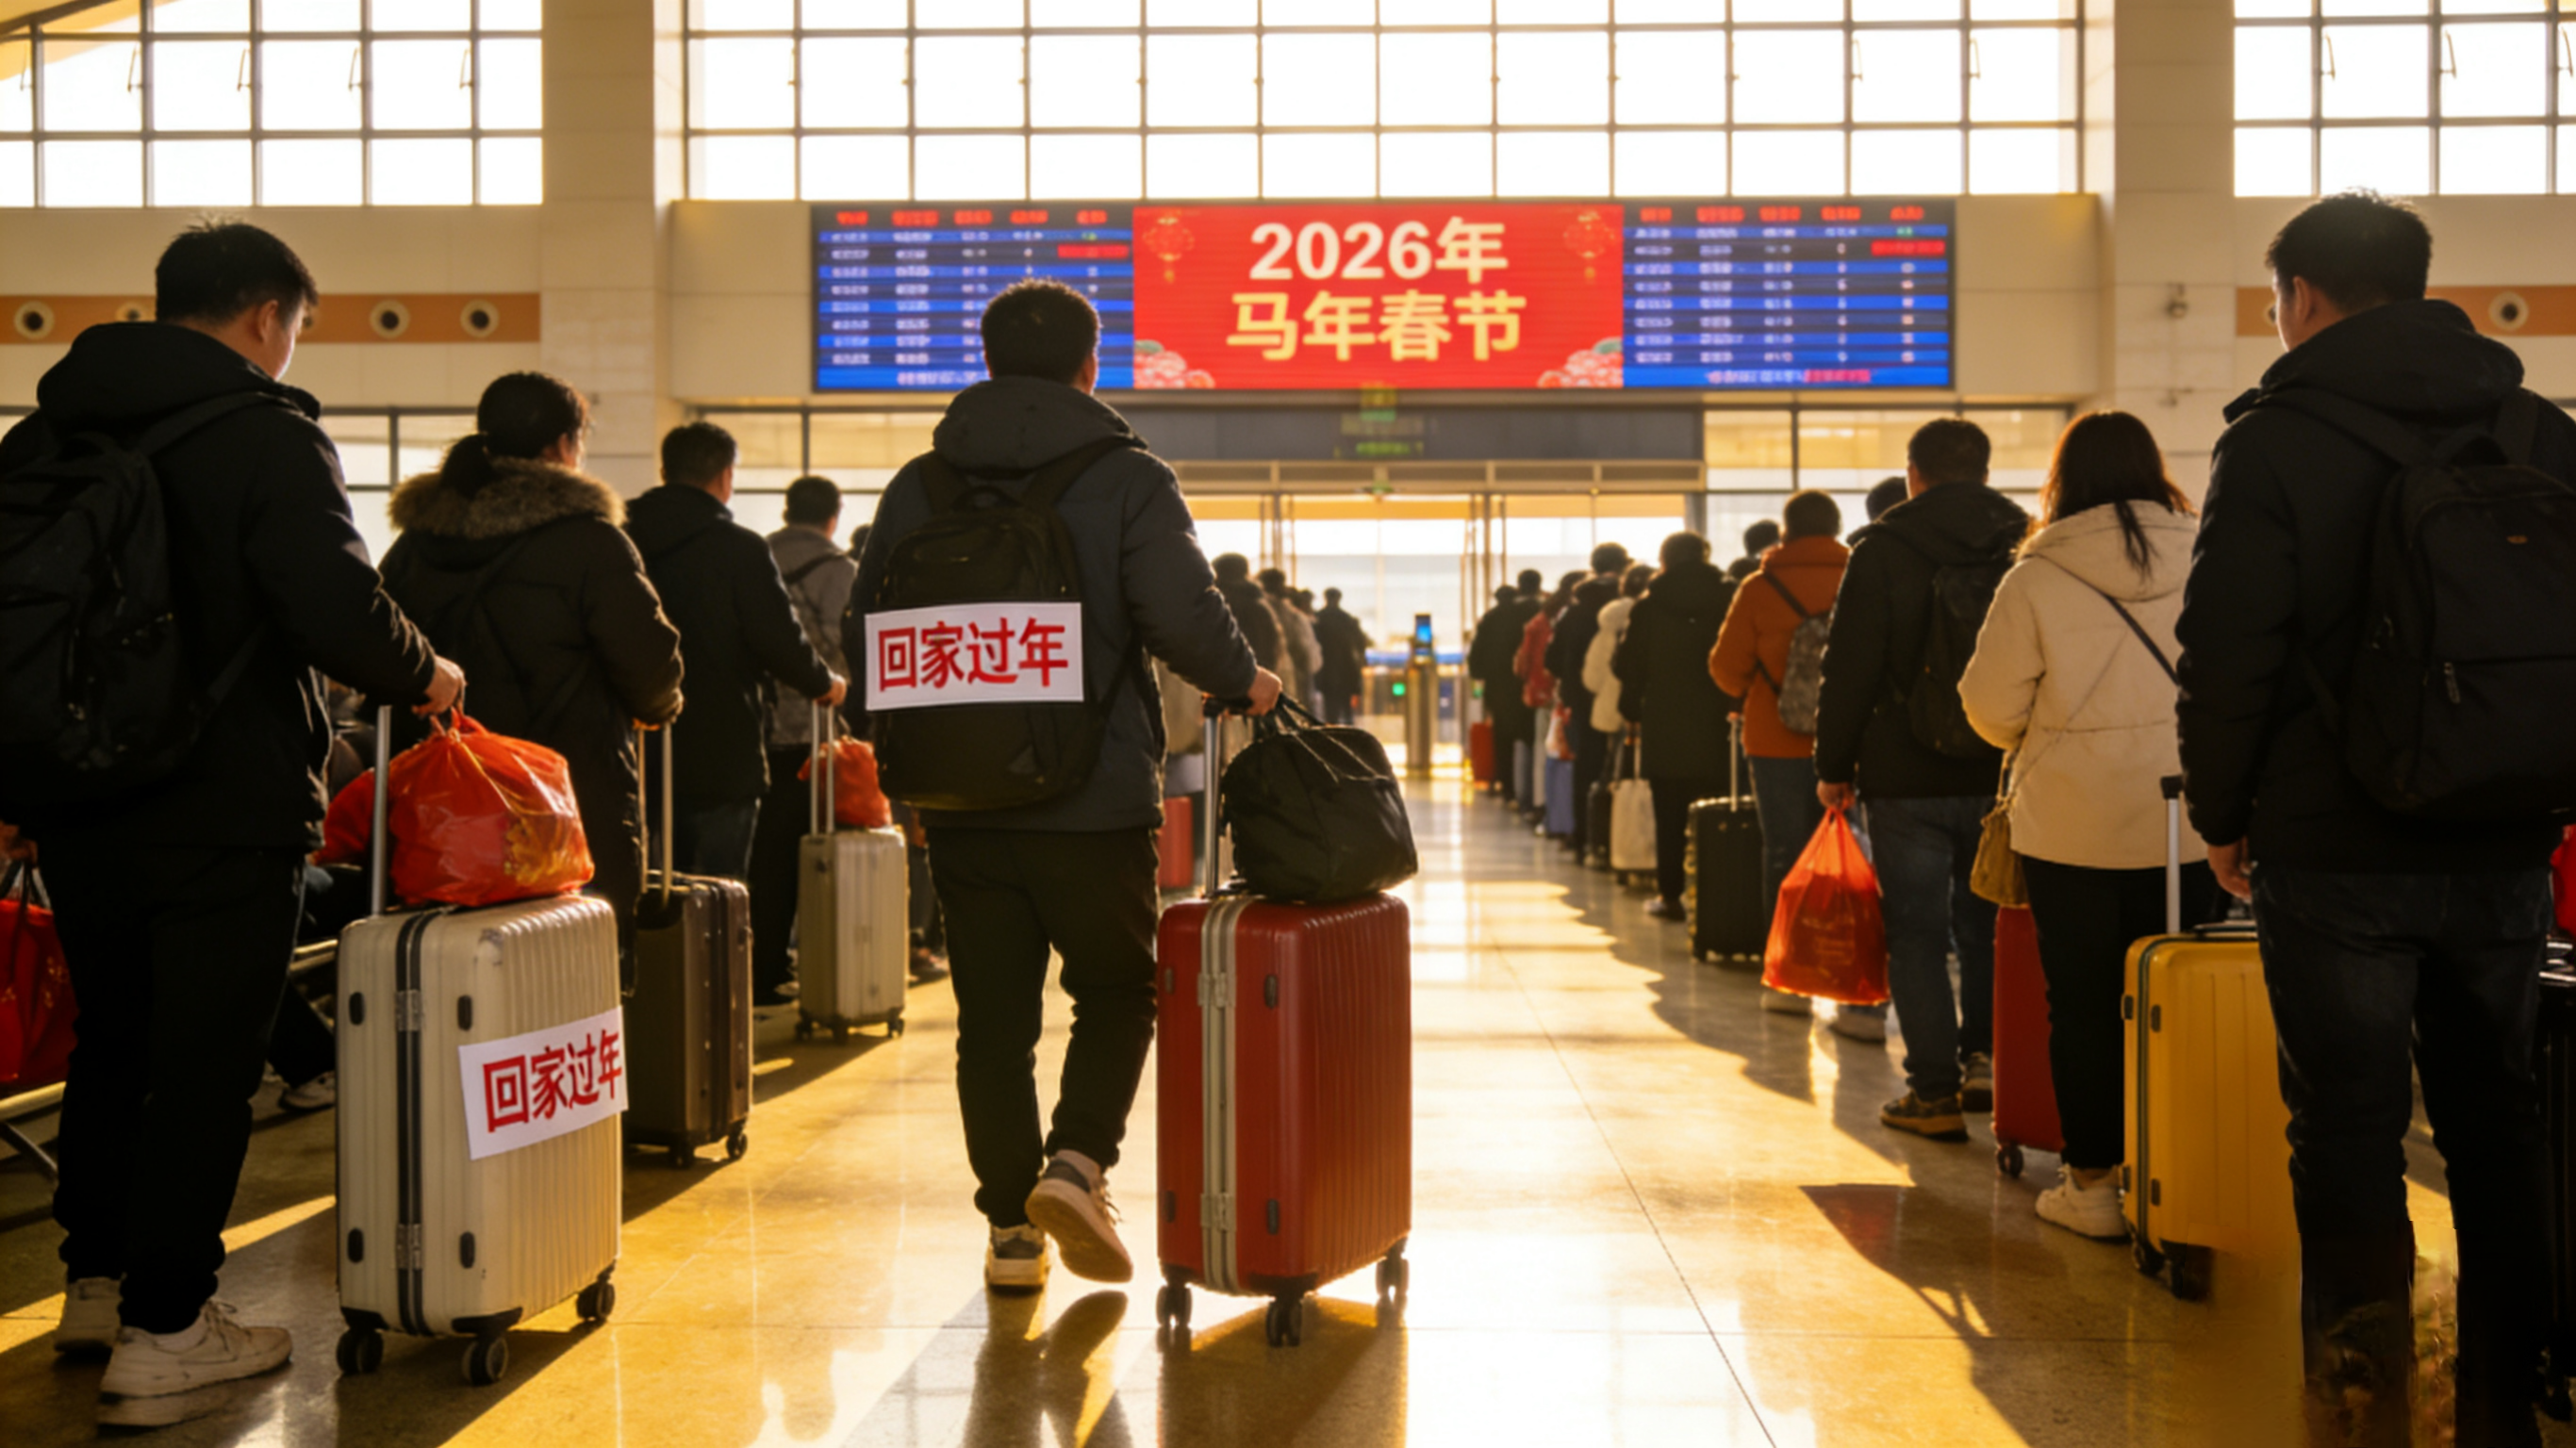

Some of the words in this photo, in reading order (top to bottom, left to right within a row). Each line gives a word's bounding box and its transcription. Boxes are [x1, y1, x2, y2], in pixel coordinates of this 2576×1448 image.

[1249, 216, 1509, 285] 2026年
[1226, 288, 1527, 361] 马年春节
[878, 617, 1069, 692] 回家过年
[482, 1028, 622, 1133] 回家过年
